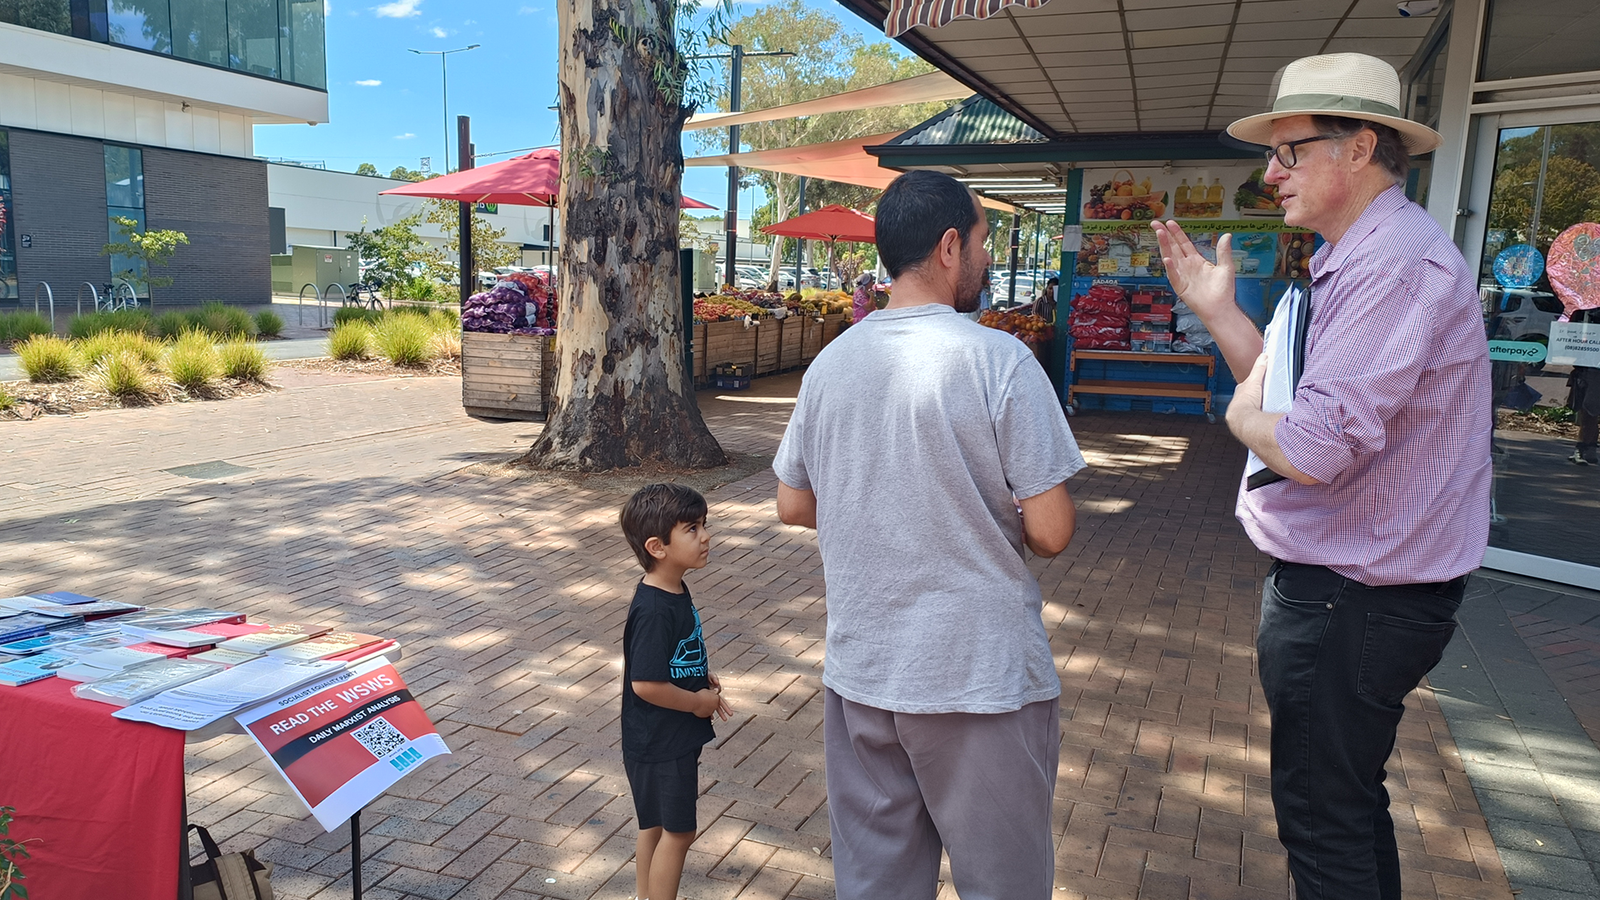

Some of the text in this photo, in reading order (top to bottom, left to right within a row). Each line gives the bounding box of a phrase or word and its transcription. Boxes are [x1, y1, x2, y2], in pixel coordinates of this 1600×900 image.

[1489, 345, 1528, 357] afterpay
[269, 673, 394, 736] READ THE WSWS
[278, 670, 358, 707] SOCIALIST EQUALITY PARTY
[308, 694, 402, 744] DAILY MARXIST ANALYSIS
